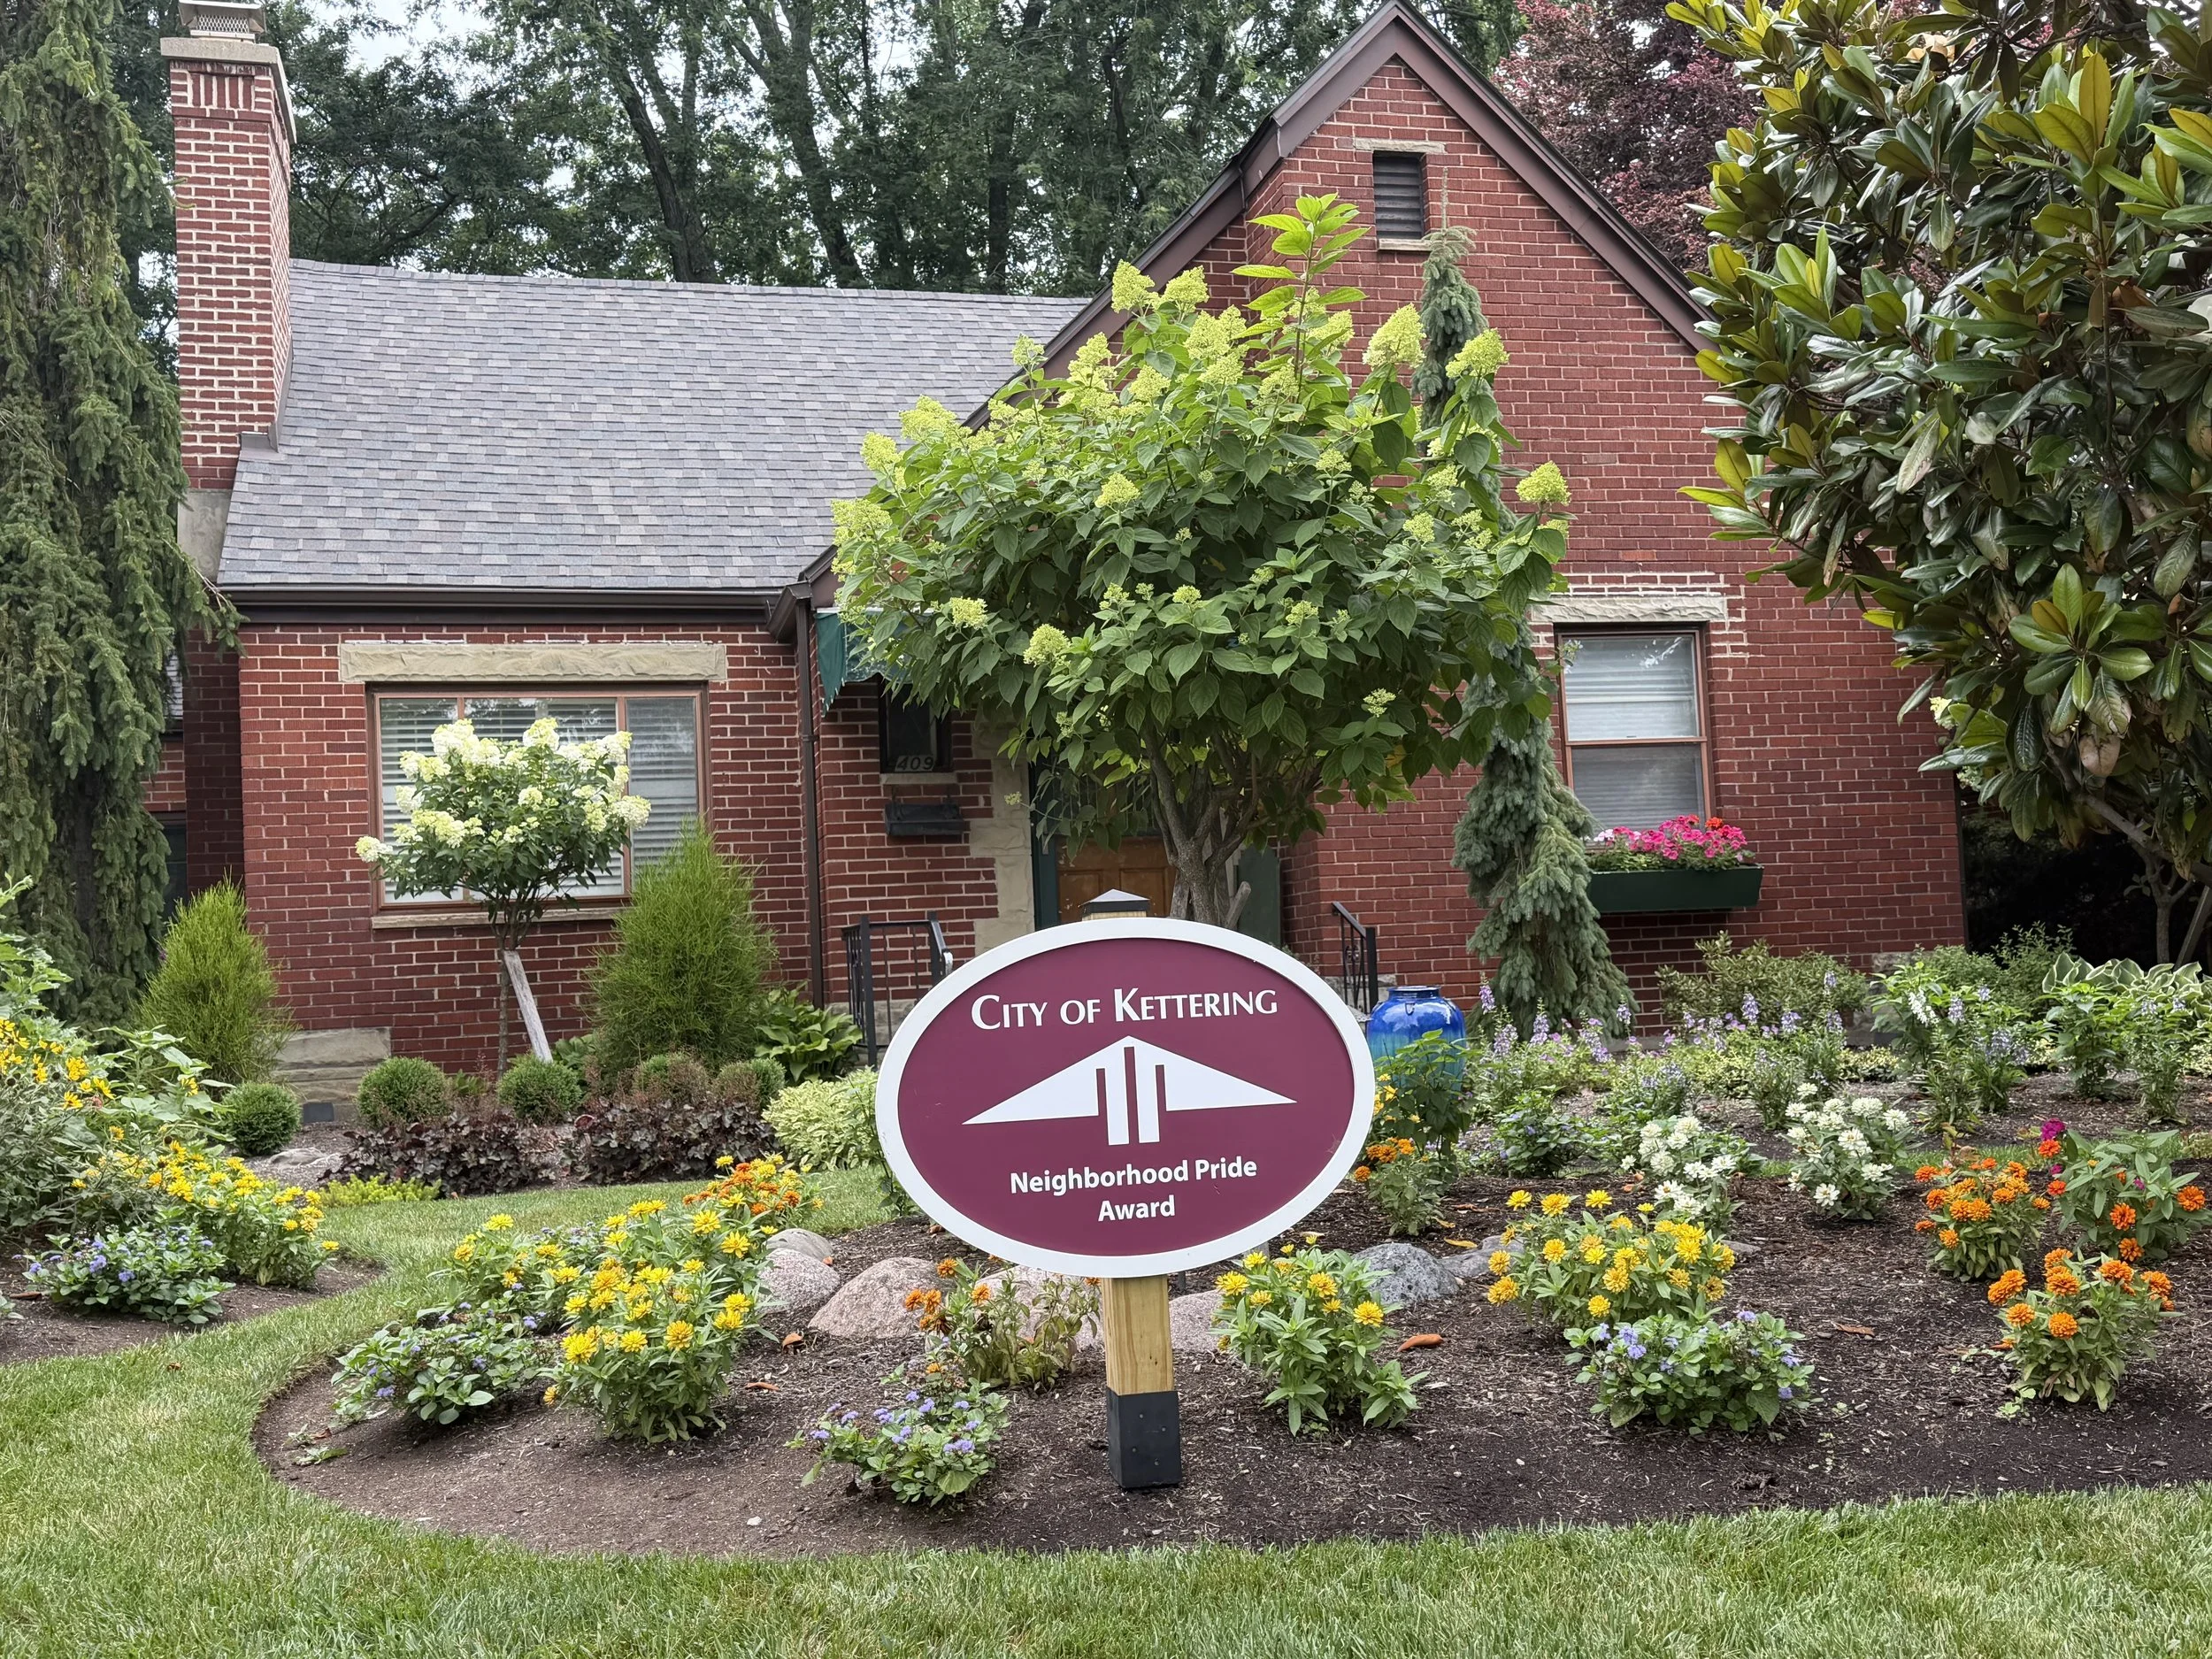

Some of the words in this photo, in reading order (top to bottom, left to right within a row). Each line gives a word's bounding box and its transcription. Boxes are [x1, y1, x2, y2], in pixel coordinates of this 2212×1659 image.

[896, 756, 934, 771] 409
[1010, 1159, 1189, 1197] Neighborhood
[1194, 1156, 1258, 1180] Pride
[1097, 1194, 1176, 1222] Award
